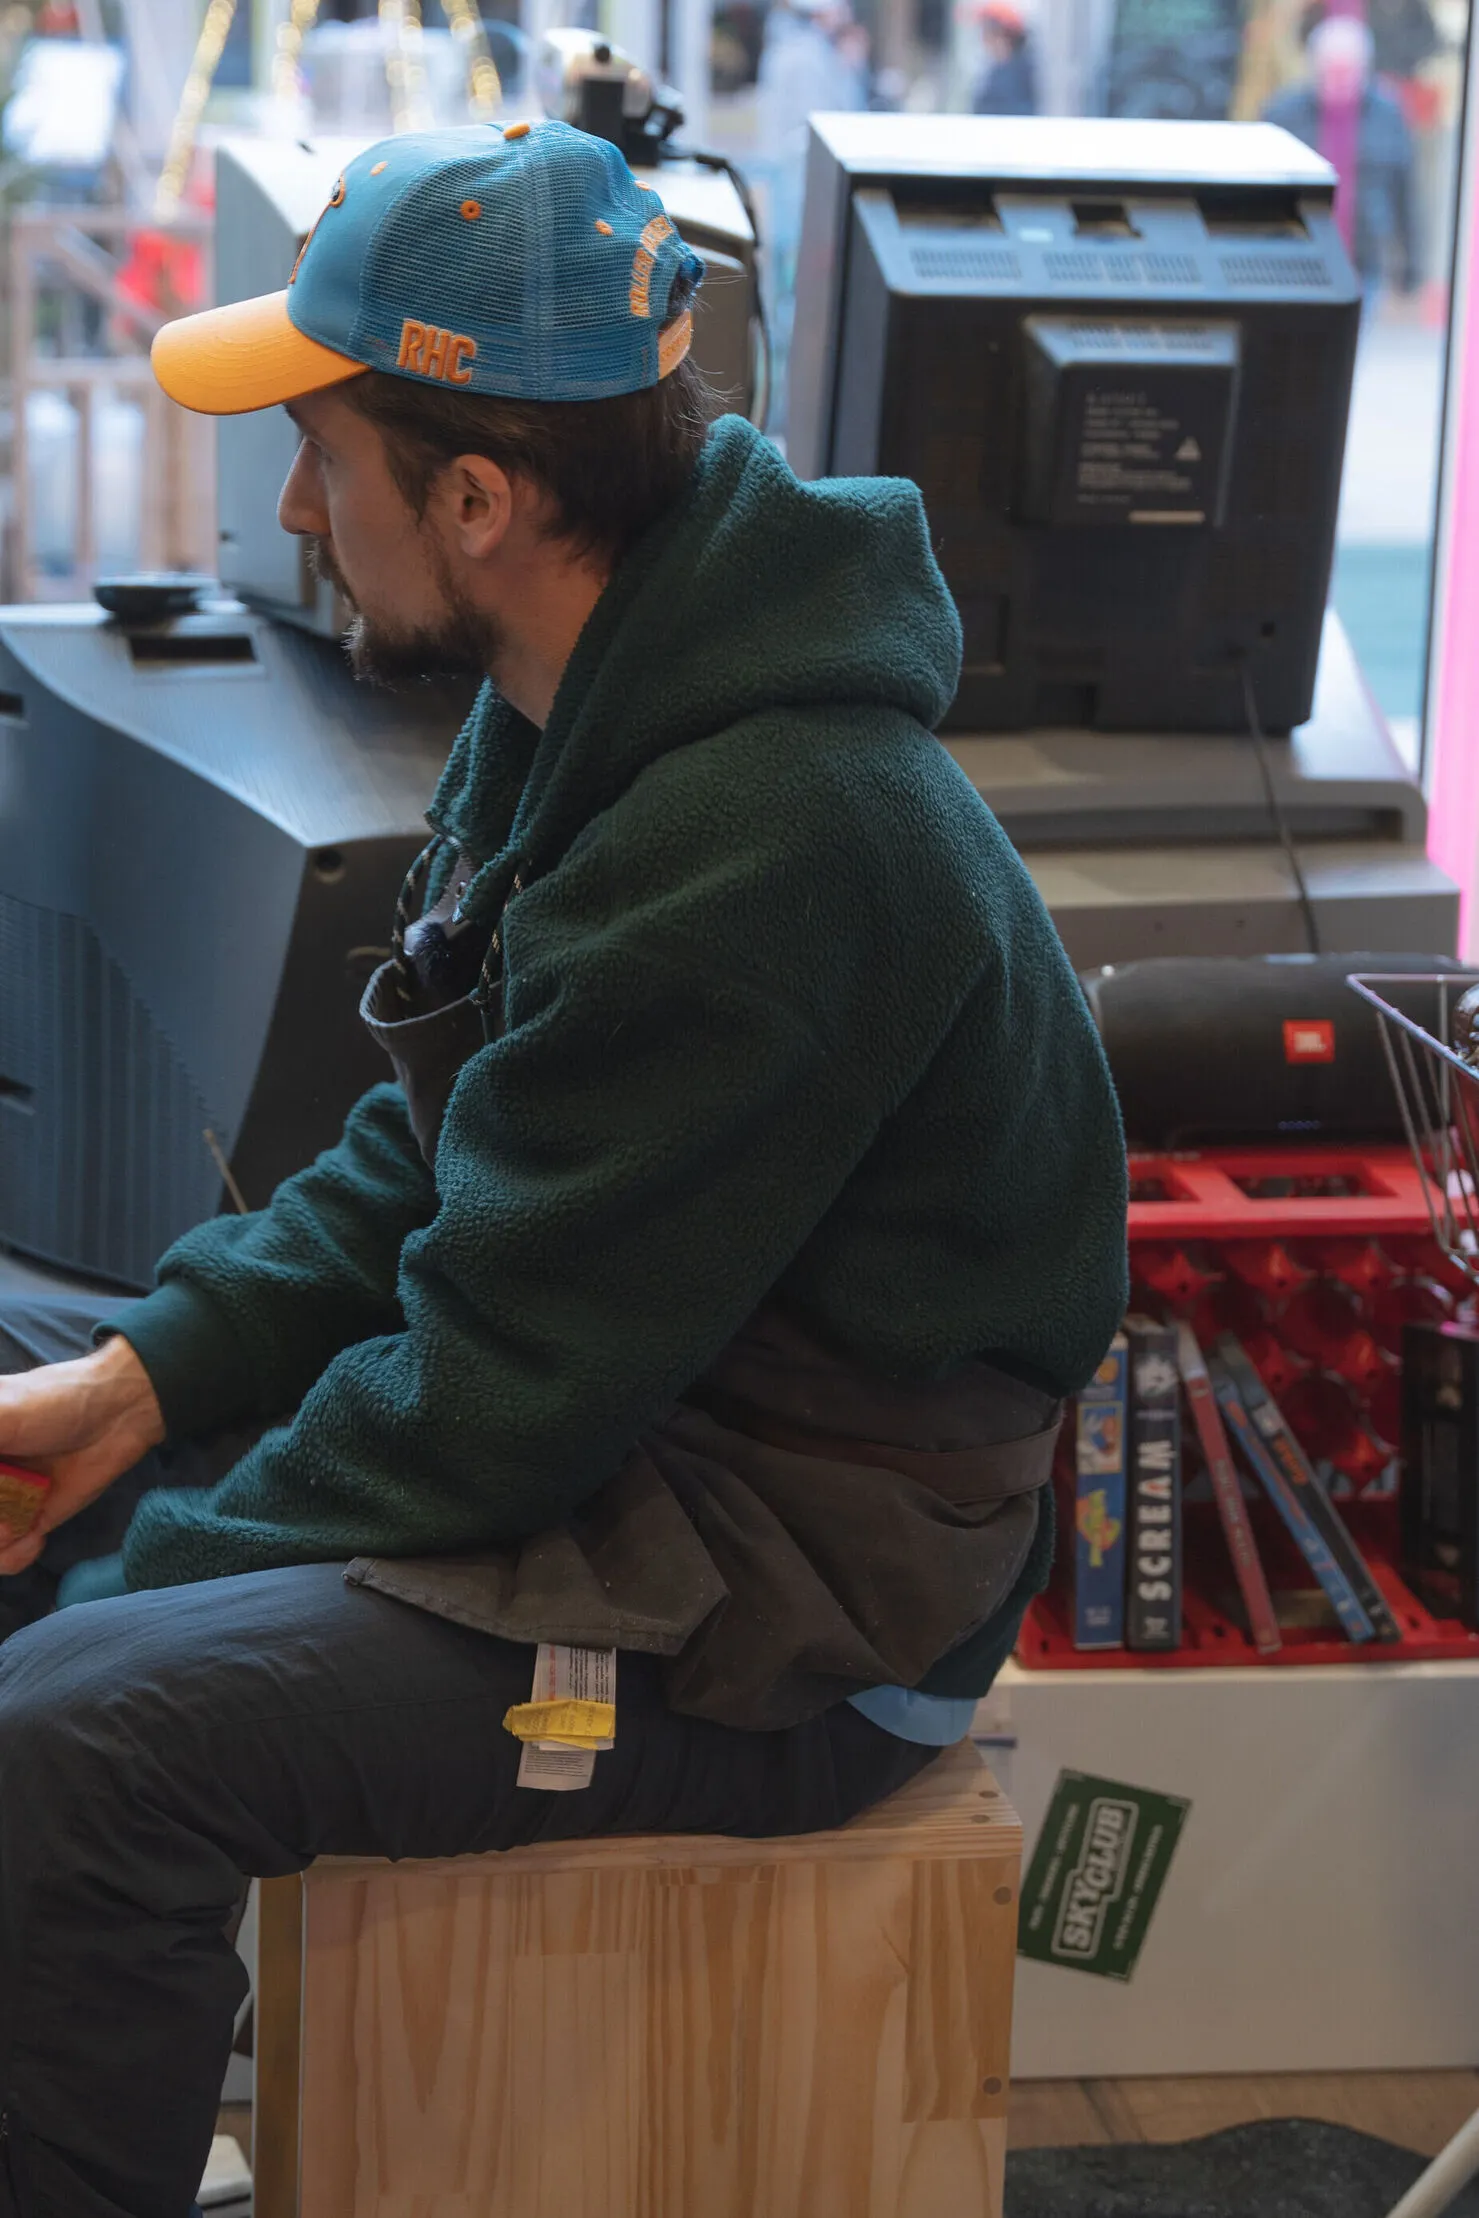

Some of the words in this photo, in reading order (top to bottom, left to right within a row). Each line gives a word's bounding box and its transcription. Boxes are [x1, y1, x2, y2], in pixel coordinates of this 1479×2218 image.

[396, 318, 476, 385] RHC
[1138, 1441, 1176, 1601] SCREAM
[1062, 1806, 1125, 1950] SKYCLUB
